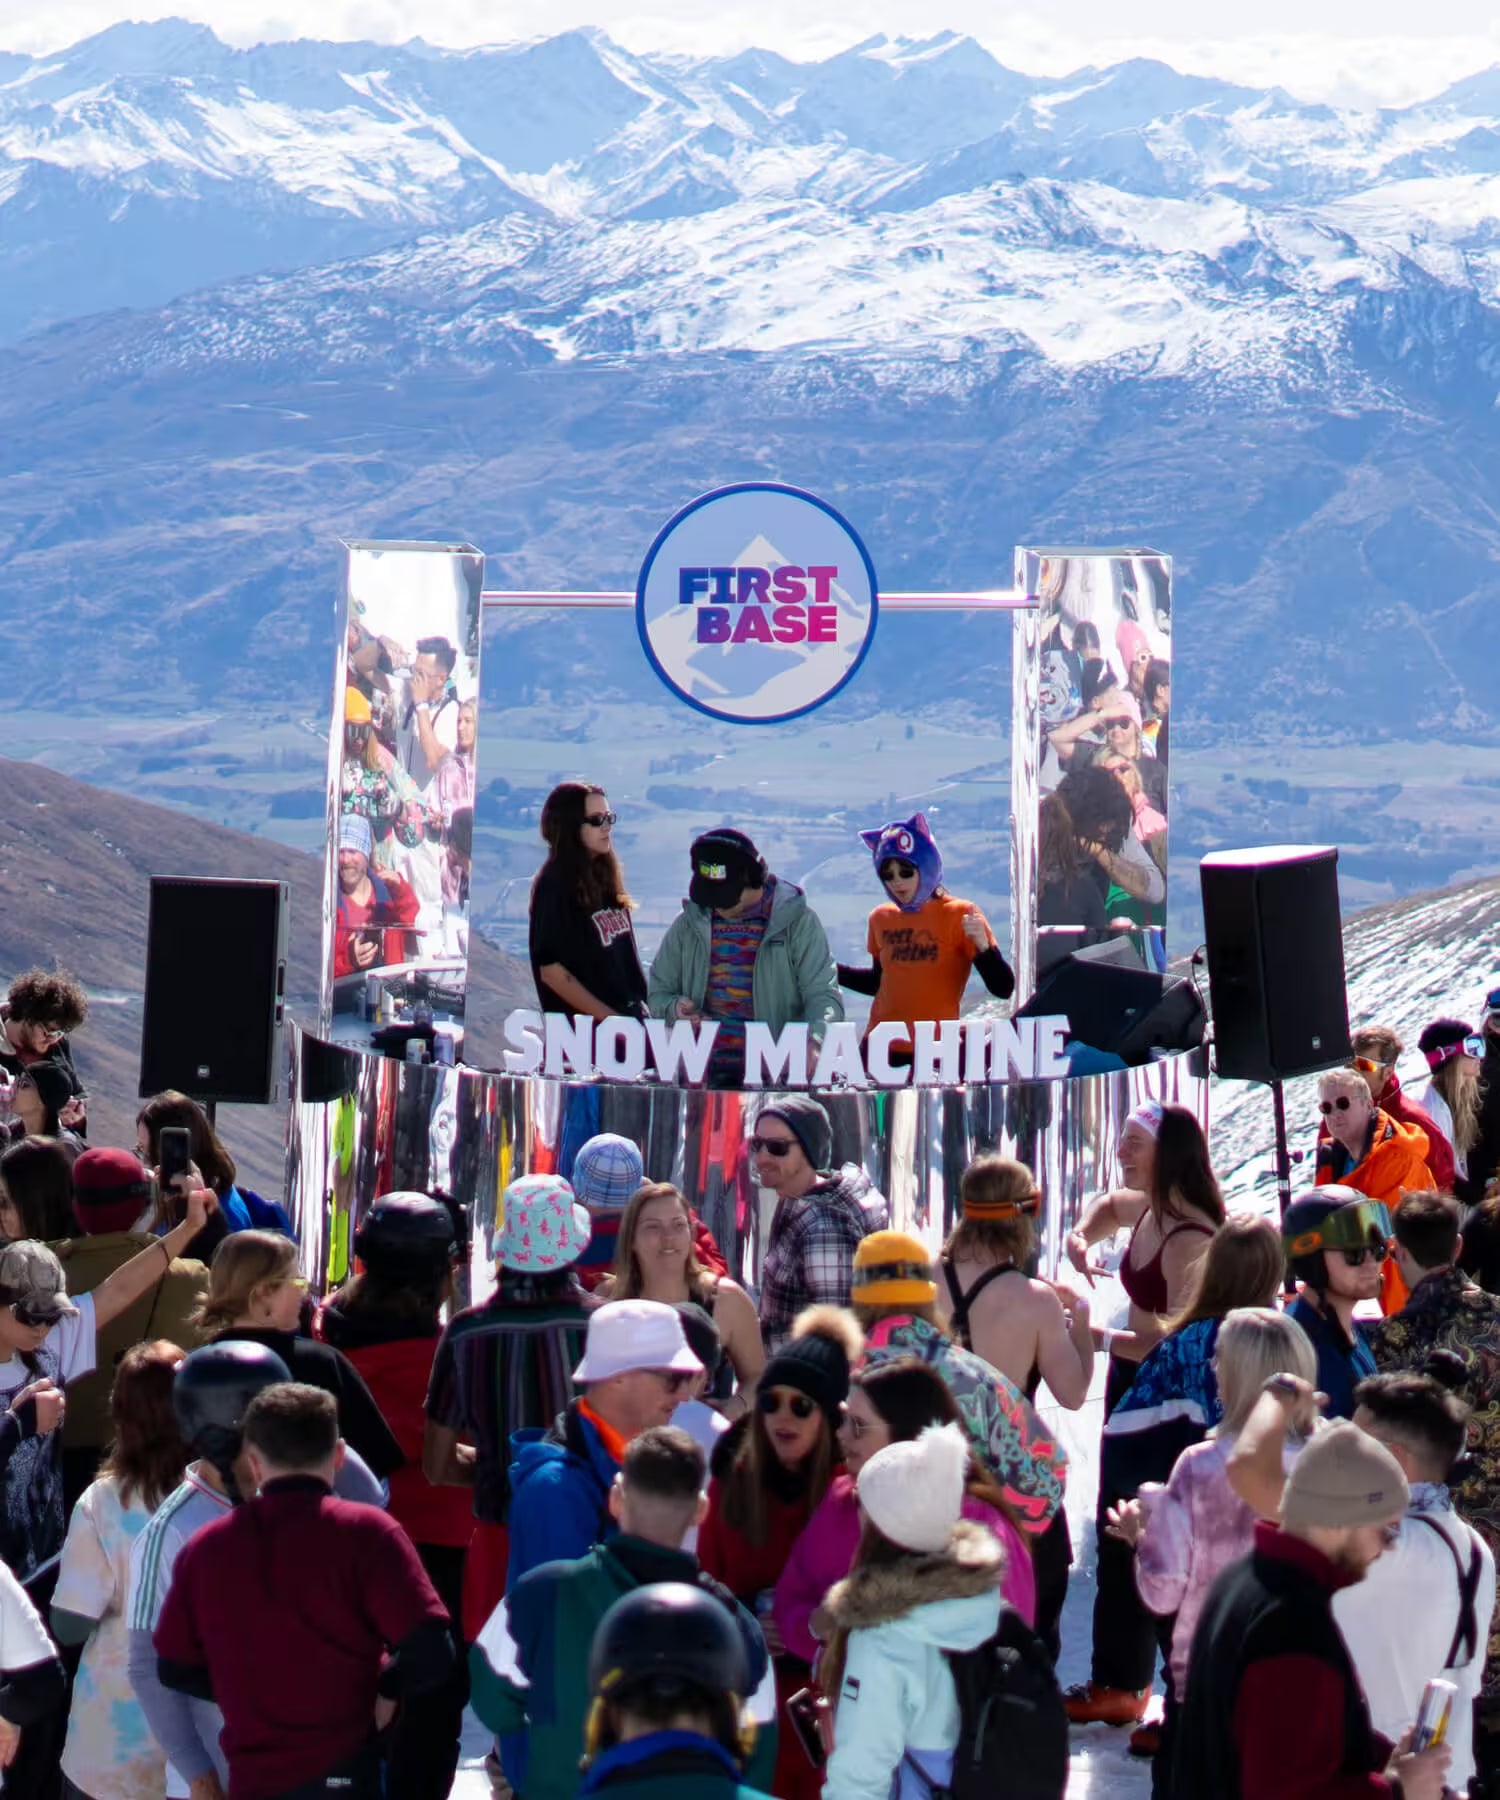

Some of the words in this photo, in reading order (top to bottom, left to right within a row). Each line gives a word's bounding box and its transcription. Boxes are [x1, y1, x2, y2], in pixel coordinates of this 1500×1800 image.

[679, 565, 838, 604] FIRST
[697, 605, 838, 643] BASE
[502, 1008, 720, 1087] SNOW
[744, 1014, 1072, 1086] MACHINE
